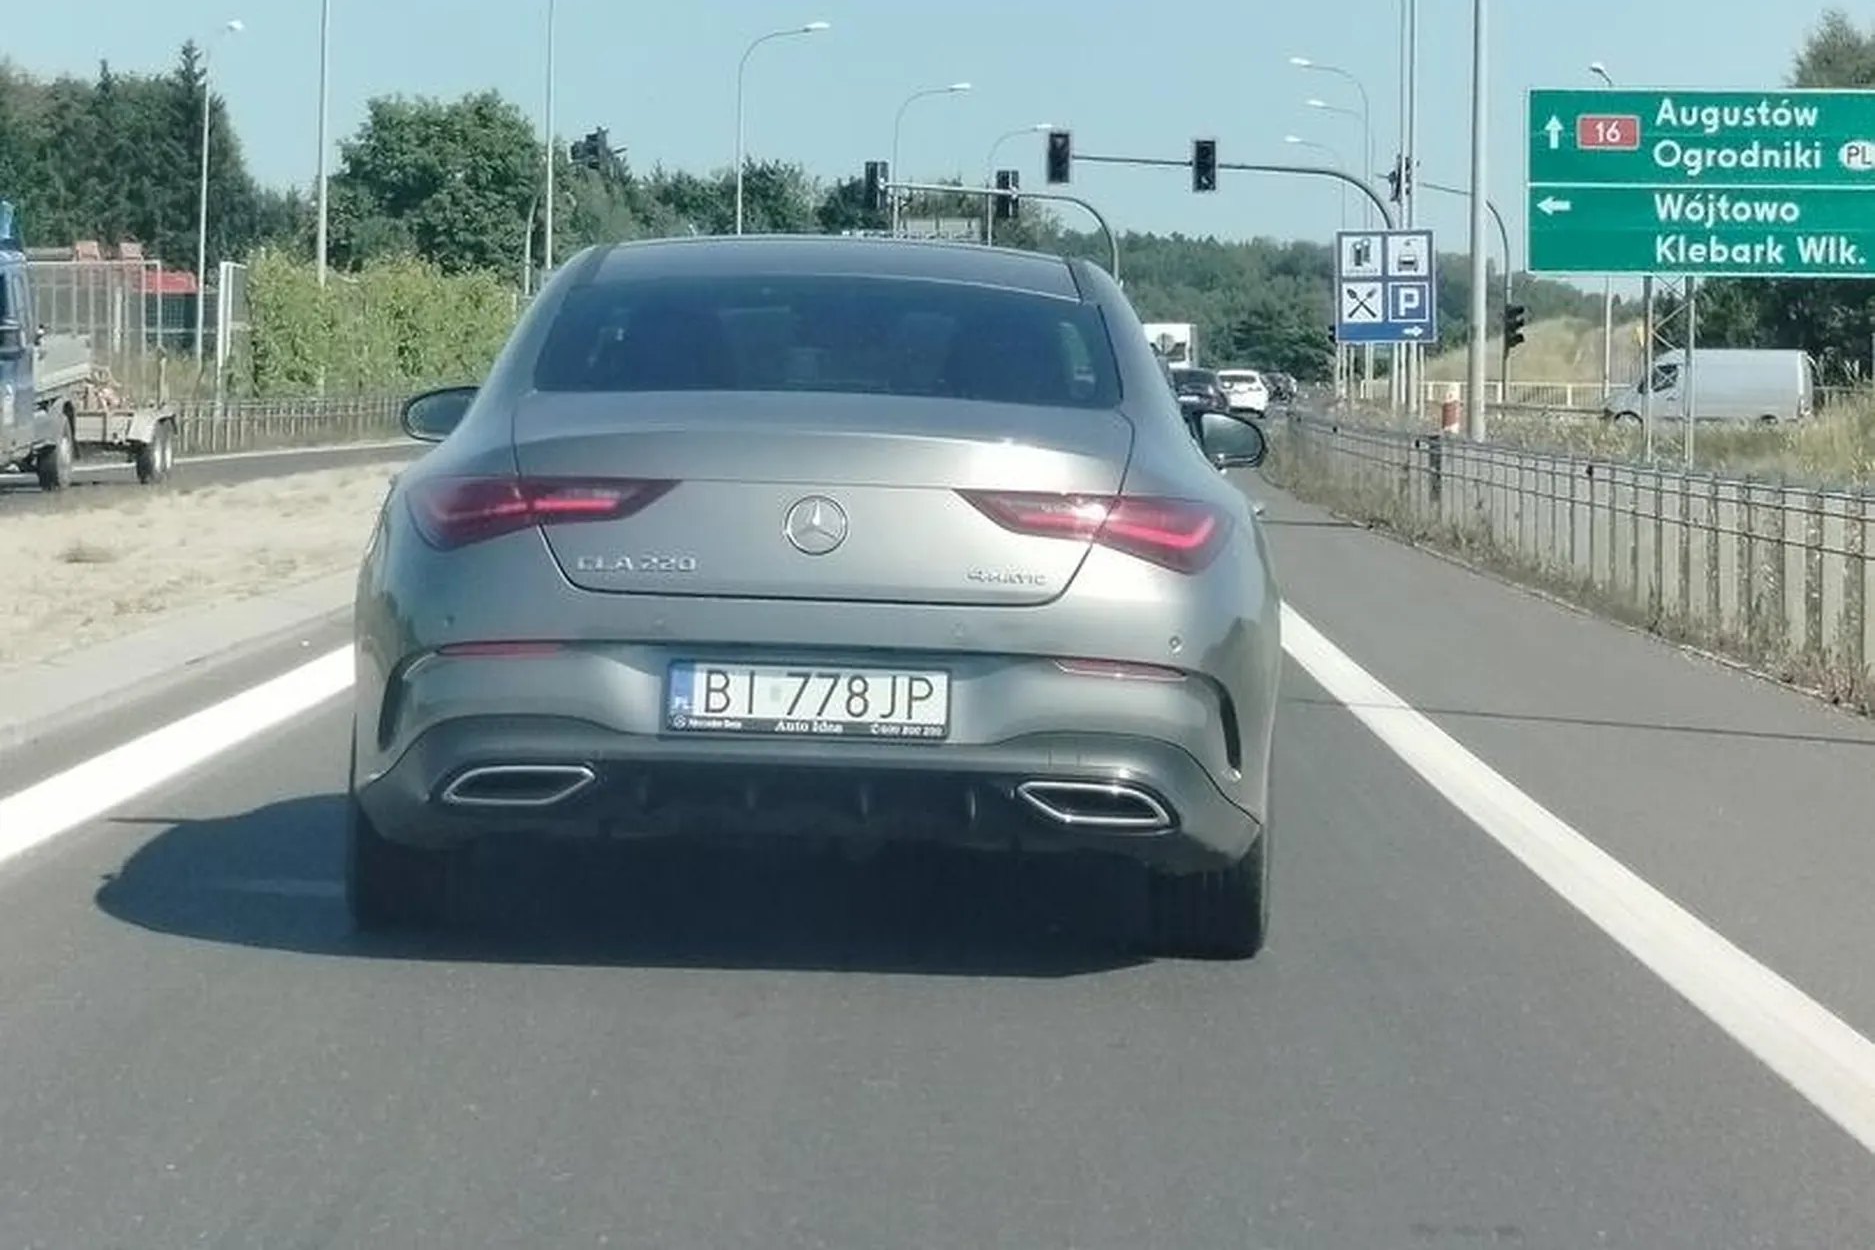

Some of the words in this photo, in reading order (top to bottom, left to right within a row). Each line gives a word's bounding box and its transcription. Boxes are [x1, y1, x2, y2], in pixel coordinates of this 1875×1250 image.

[1654, 98, 1818, 134] Augustów
[1595, 121, 1621, 144] 16
[1653, 139, 1822, 176] Ogrodniki
[1847, 145, 1872, 166] PL
[1654, 192, 1799, 228] Wójtowo
[1655, 234, 1785, 264] Klebark
[1796, 235, 1867, 264] Wlk.
[640, 555, 697, 571] 220
[704, 669, 755, 715] BI
[786, 671, 934, 720] 778JP
[774, 719, 809, 732] Auto
